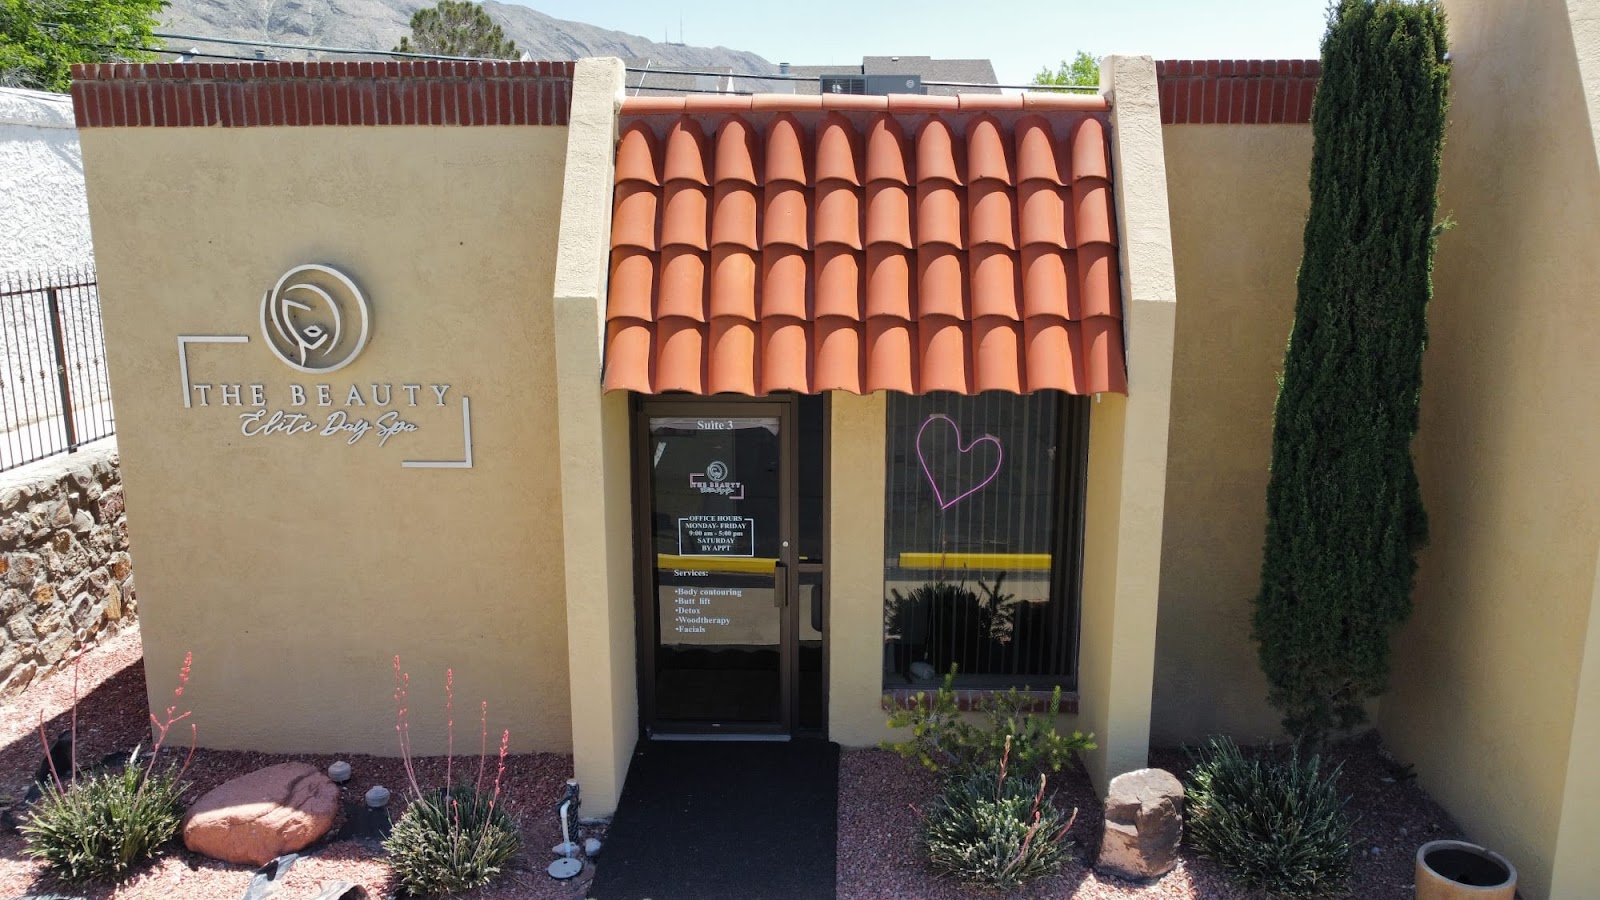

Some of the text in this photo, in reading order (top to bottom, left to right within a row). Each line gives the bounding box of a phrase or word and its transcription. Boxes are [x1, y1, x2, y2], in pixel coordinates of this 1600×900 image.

[193, 384, 450, 407] THE BEAUTY
[239, 409, 418, 447] Elite Day Spa
[697, 420, 734, 430] Suite 3
[700, 588, 742, 597] contouring
